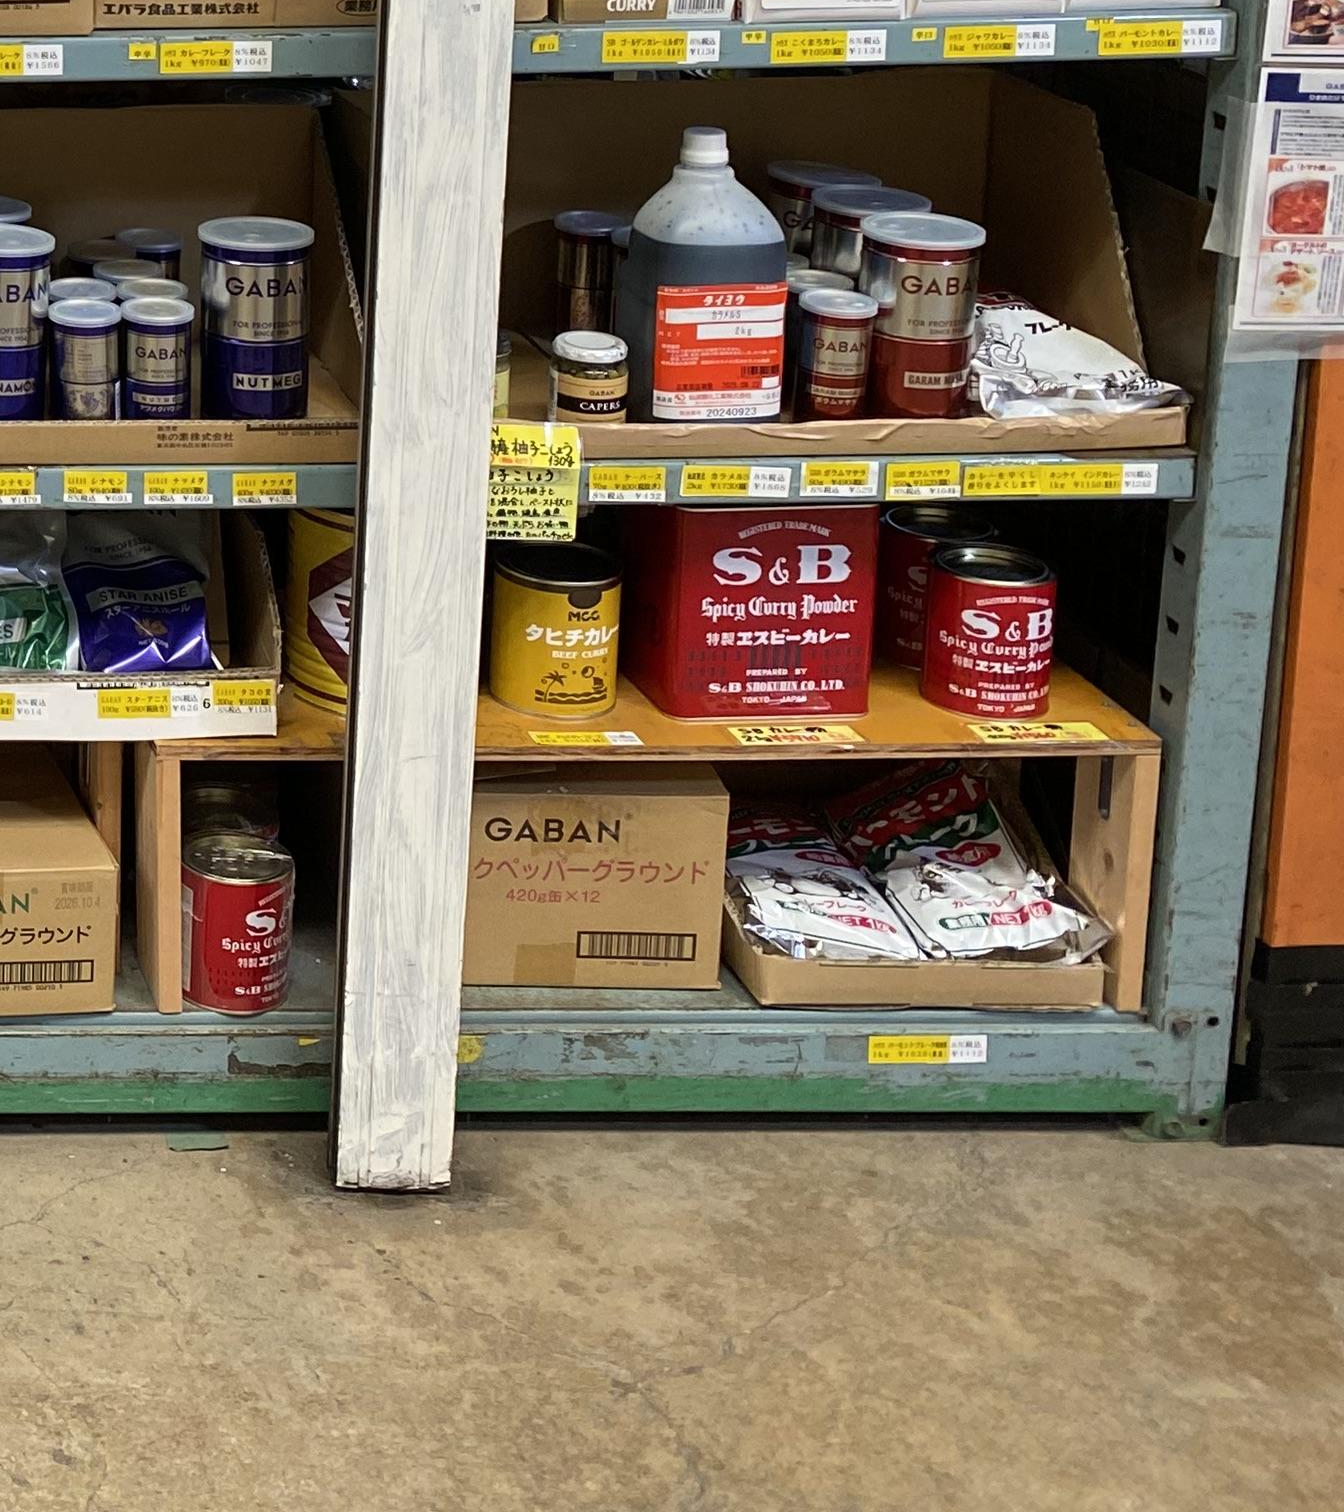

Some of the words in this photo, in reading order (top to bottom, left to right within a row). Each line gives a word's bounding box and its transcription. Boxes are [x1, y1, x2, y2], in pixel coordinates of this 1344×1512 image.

[102, 1, 260, 17] エバラ食品工業株式会社
[234, 372, 303, 390] NUTMEG
[711, 544, 853, 587] S&B
[98, 587, 137, 605] STAR
[140, 585, 188, 603] ANISE
[700, 595, 748, 620] Spicy
[750, 595, 803, 622] Curry
[804, 593, 860, 617] Powder
[960, 606, 1054, 641] S&B
[484, 815, 622, 845] GABAN
[505, 888, 601, 907] 420g缶×12
